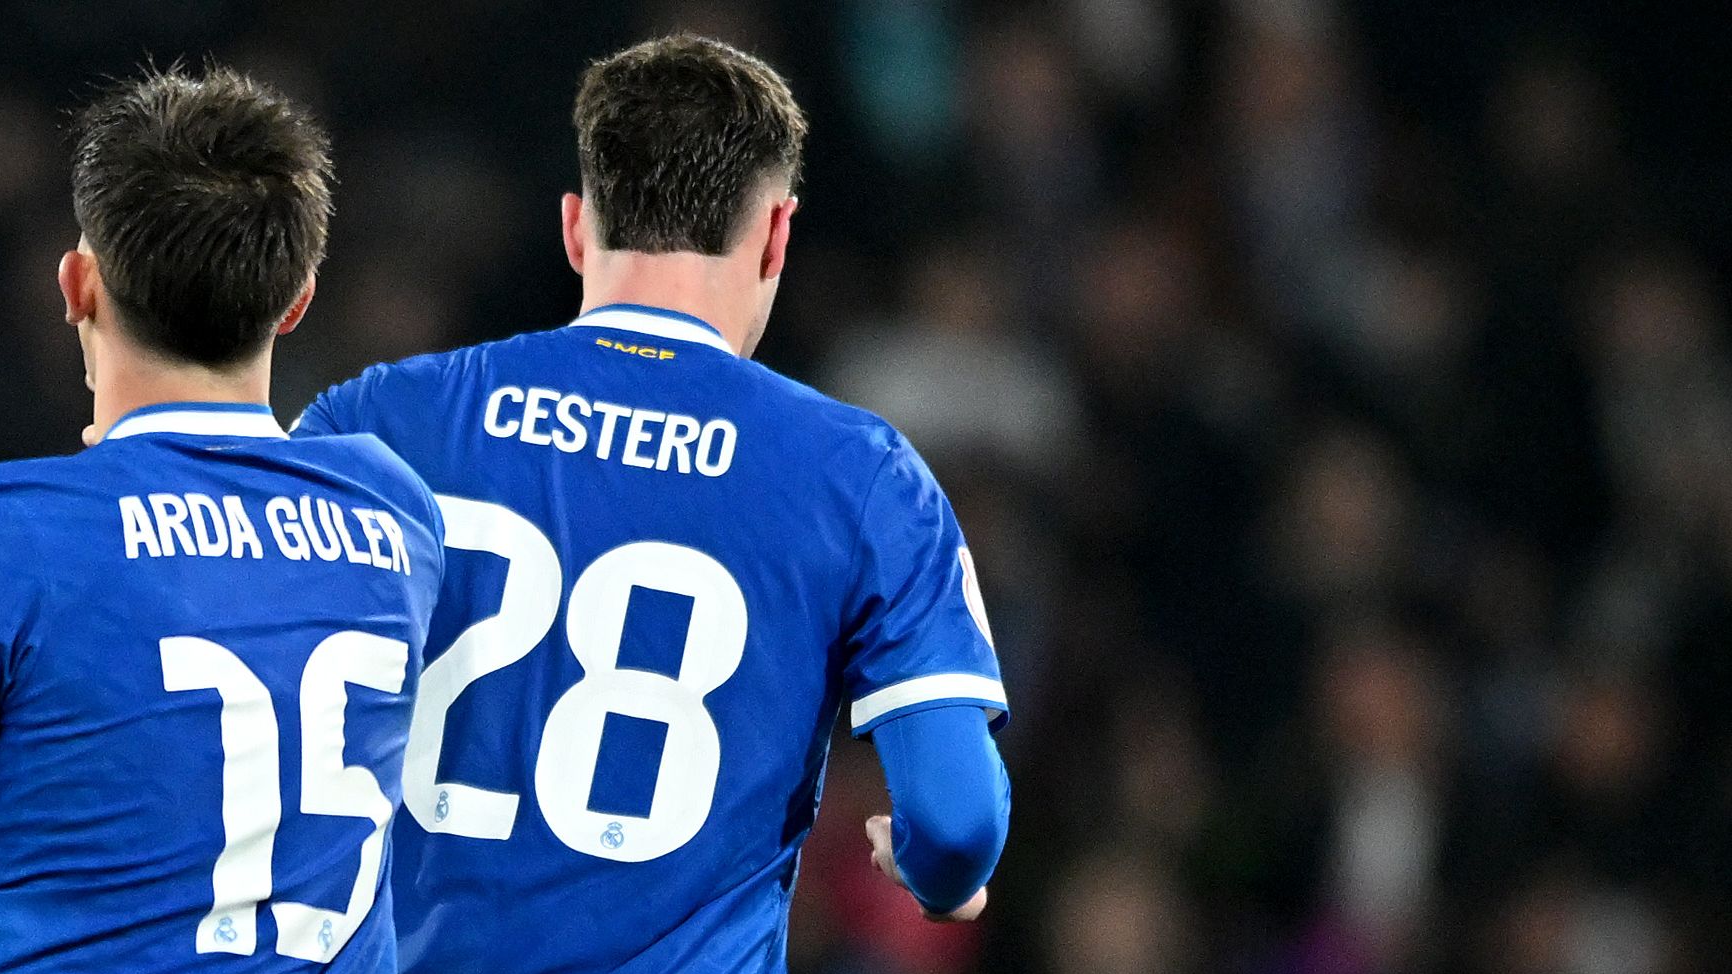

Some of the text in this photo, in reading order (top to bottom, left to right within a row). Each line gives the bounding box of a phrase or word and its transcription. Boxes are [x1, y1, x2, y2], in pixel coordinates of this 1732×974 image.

[118, 493, 264, 560] ARDA
[483, 386, 738, 478] CESTERO
[402, 494, 748, 863] 28
[159, 630, 410, 964] 15
